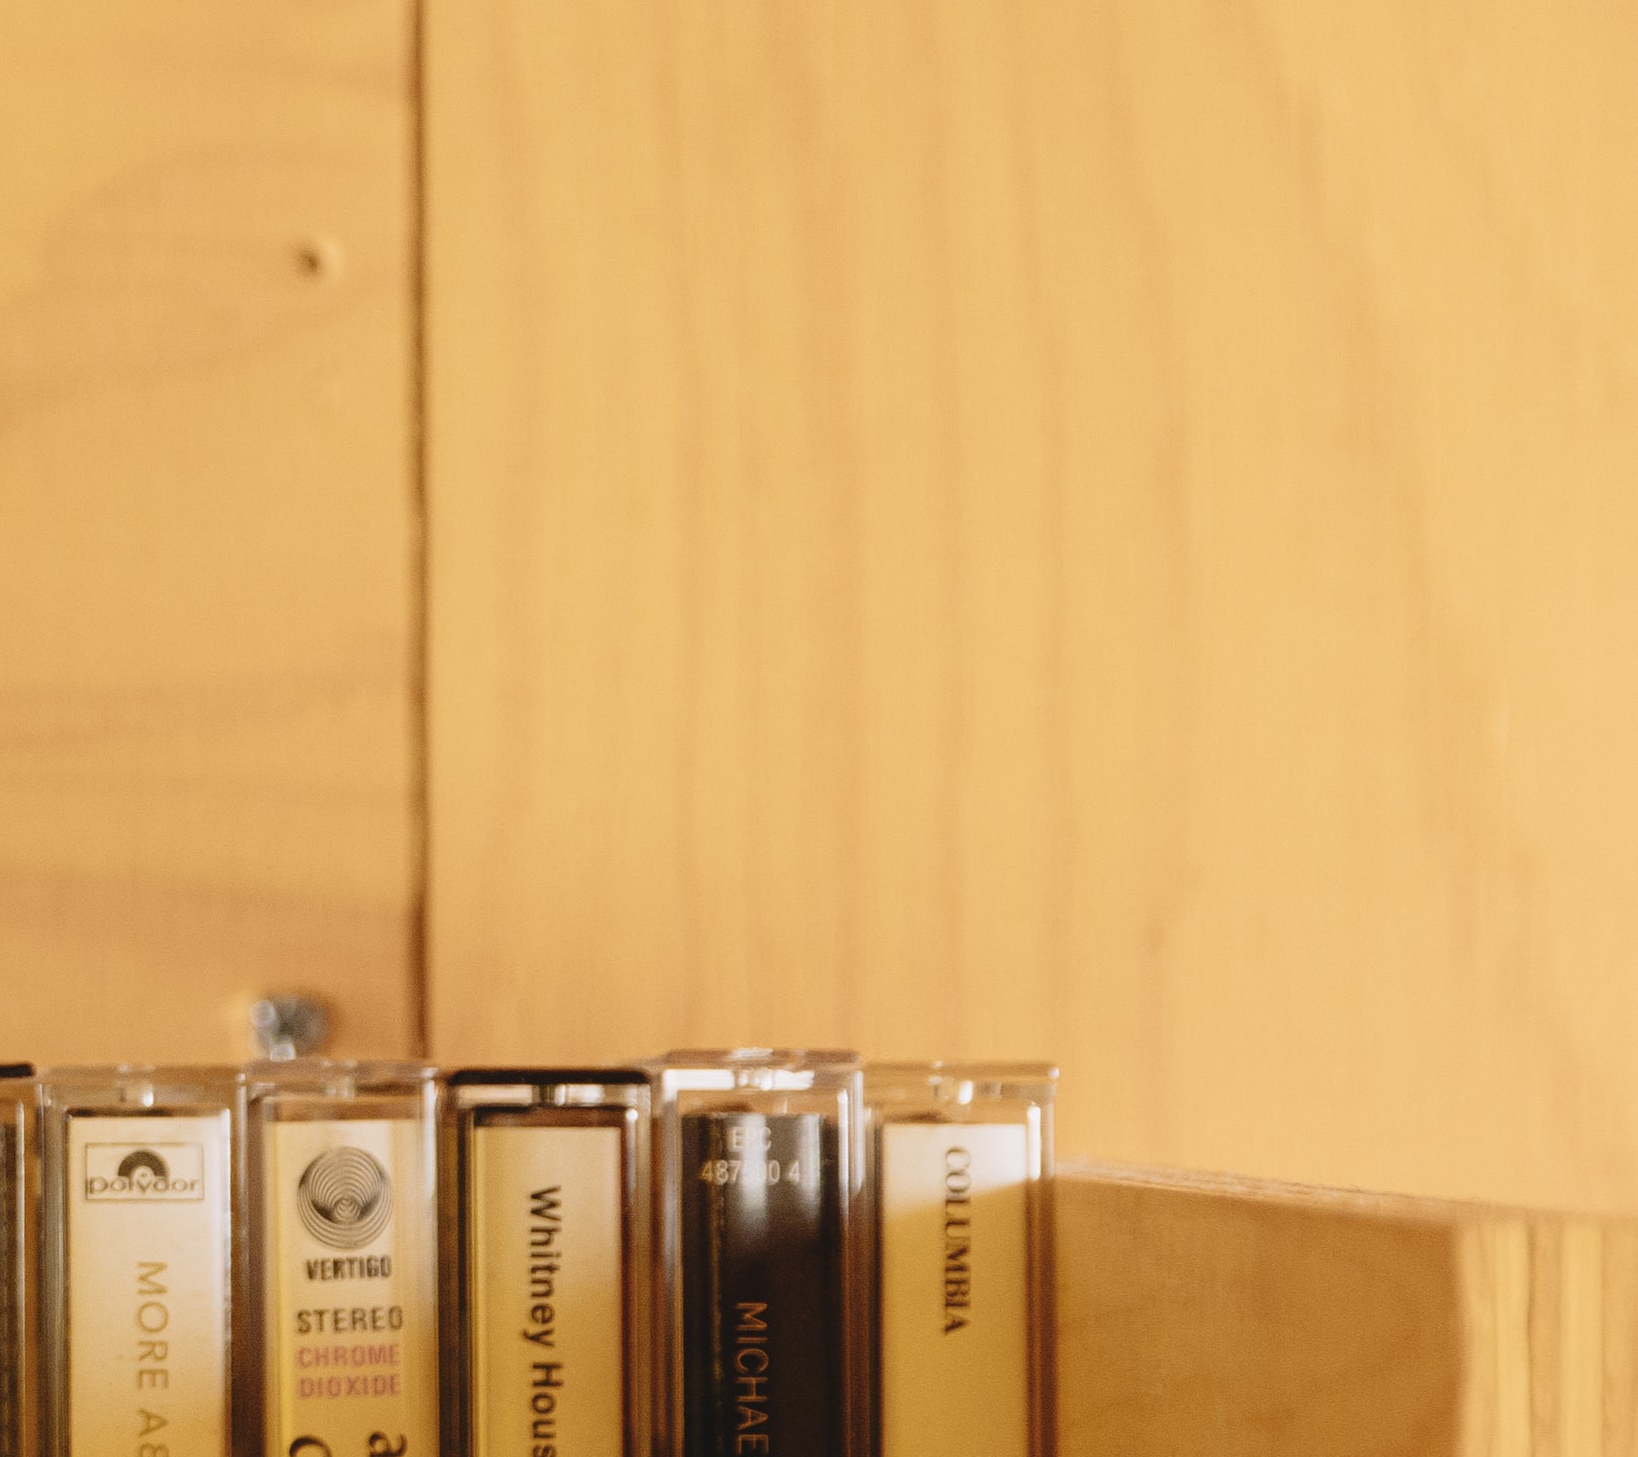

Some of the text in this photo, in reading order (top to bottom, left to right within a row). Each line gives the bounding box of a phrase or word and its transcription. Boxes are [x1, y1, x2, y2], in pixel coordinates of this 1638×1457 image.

[944, 1147, 972, 1337] COLUMBIA
[306, 1257, 390, 1280] VERTIGO
[516, 1184, 563, 1349] Whitney
[134, 1264, 170, 1392] MORE
[297, 1306, 403, 1334] STEREO
[299, 1344, 398, 1368] CHROME
[301, 1374, 400, 1398] DIOXIDE
